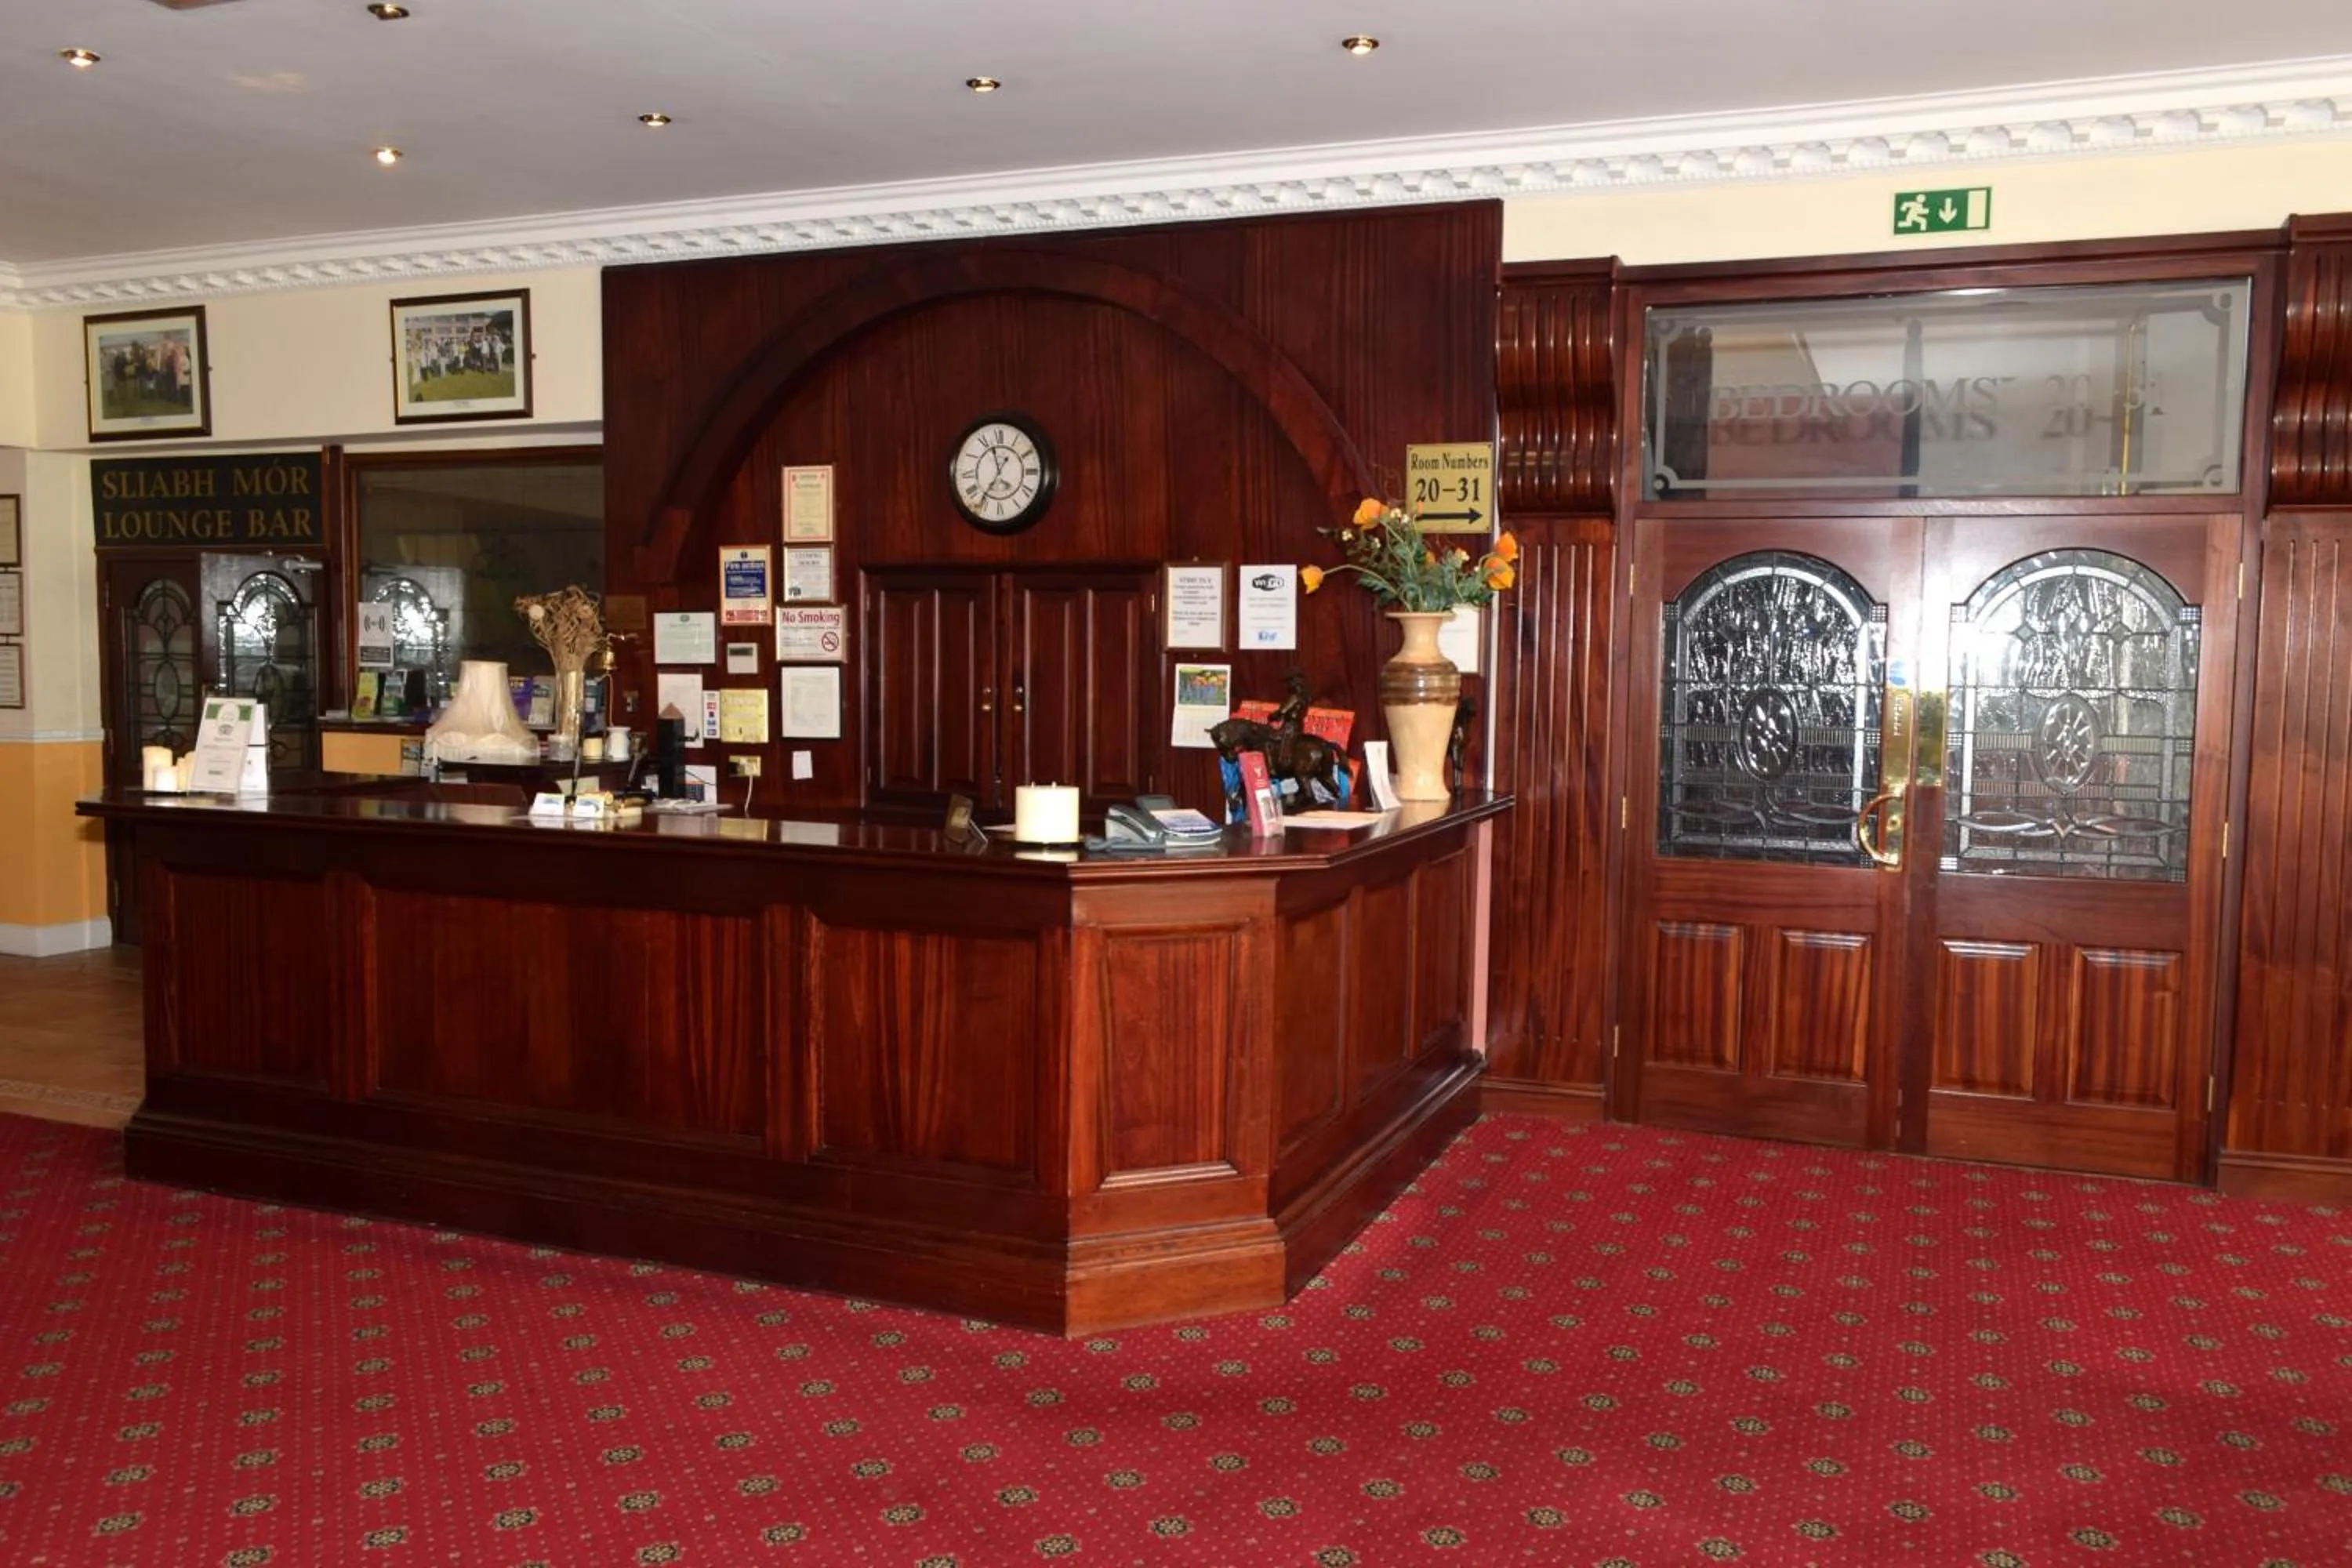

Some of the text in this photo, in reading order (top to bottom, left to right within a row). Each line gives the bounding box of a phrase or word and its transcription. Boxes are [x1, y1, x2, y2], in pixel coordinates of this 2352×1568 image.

[1709, 376, 1999, 420] BEDROOMS
[1411, 452, 1490, 470] Room Numbers
[101, 468, 215, 499] SLIABH
[103, 507, 312, 539] LOUNGE BAR
[782, 611, 796, 622] No
